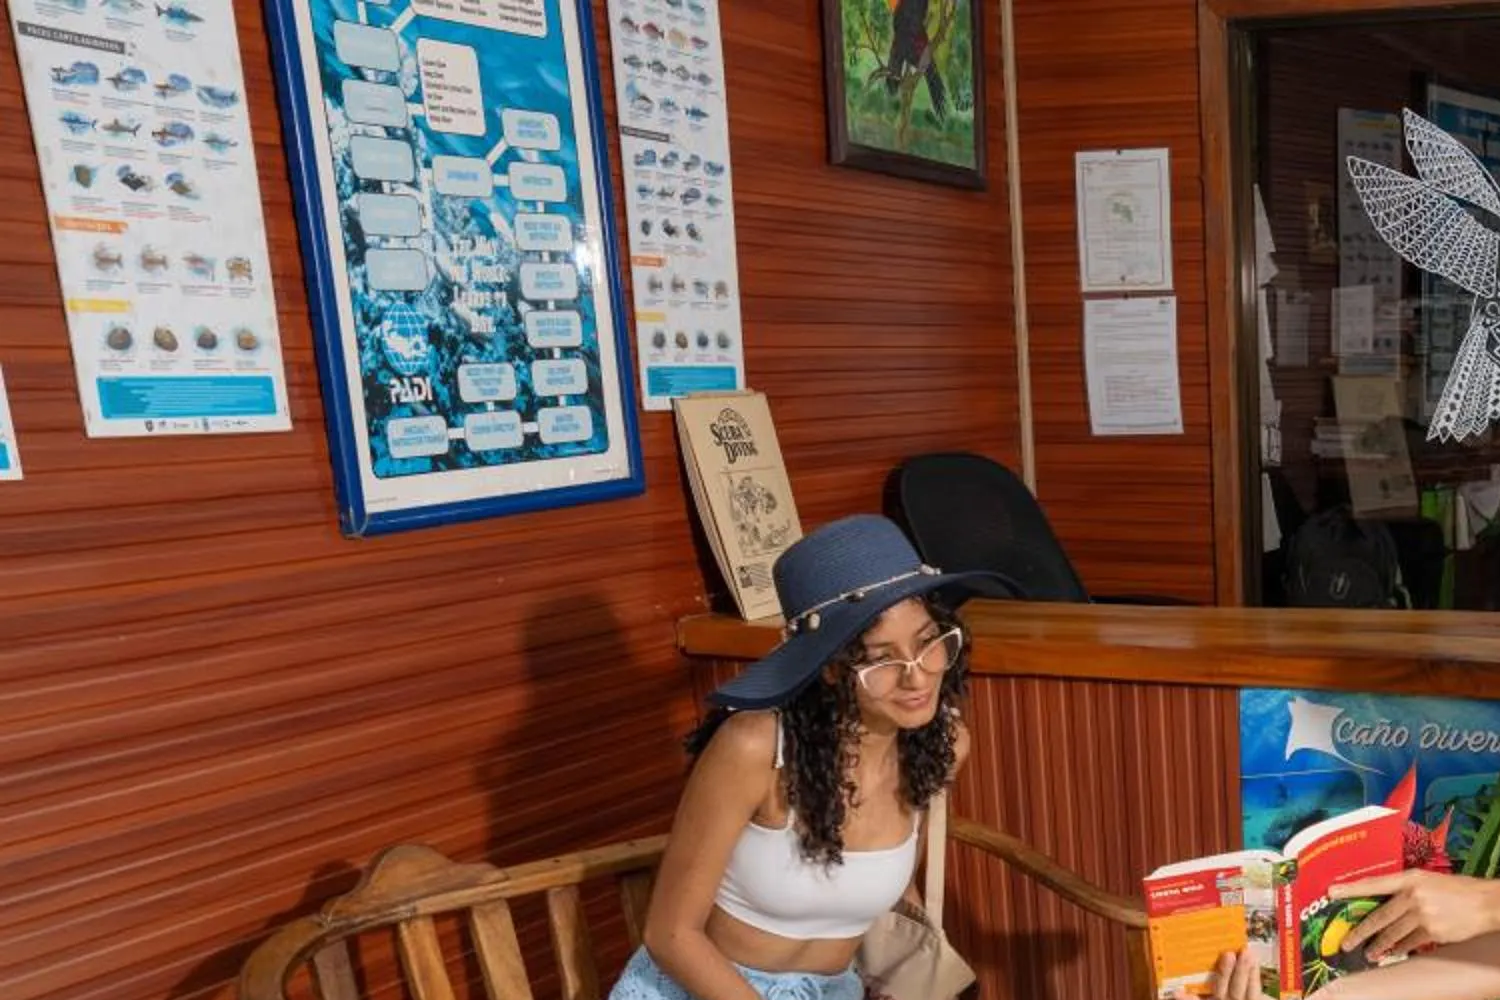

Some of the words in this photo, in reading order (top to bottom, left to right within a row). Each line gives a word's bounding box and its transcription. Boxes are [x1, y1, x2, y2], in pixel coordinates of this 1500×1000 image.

[389, 376, 433, 403] PADI
[1334, 714, 1410, 748] Caño
[1300, 895, 1330, 921] COS
